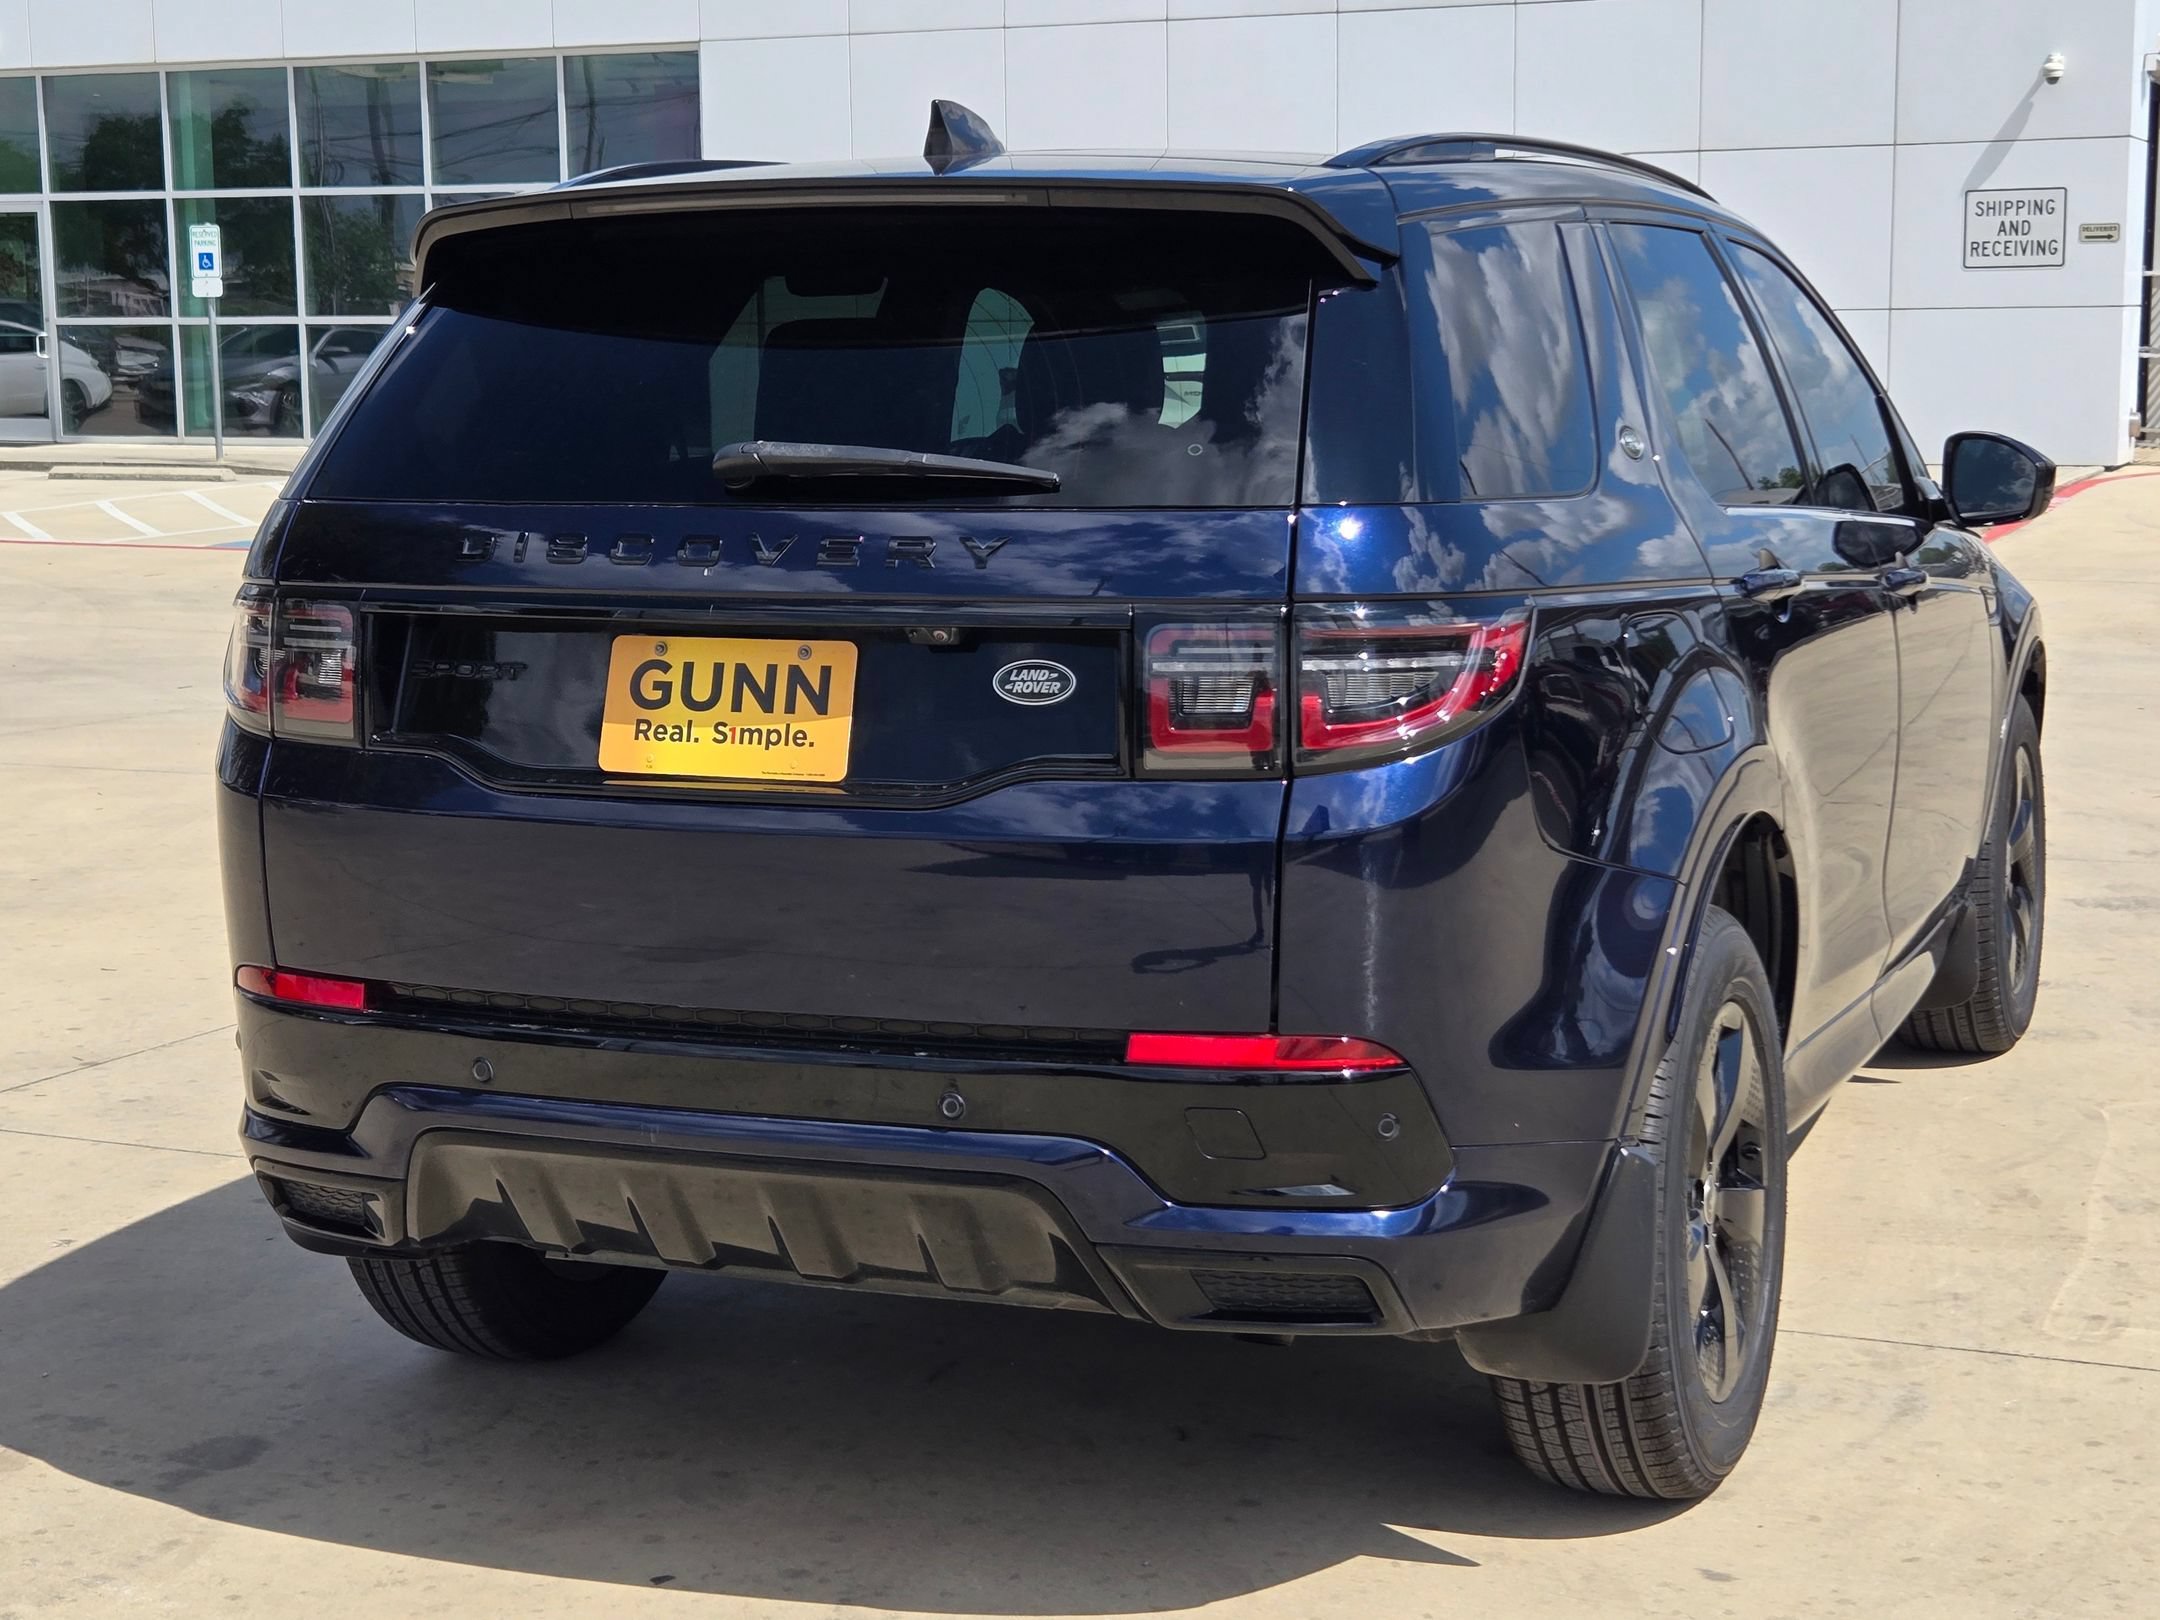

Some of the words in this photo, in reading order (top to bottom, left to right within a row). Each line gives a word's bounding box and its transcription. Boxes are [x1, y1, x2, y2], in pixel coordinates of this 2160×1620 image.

[1975, 199, 2055, 217] SHIPPING
[1997, 220, 2031, 236] AND
[1970, 240, 2058, 257] RECEIVING
[455, 530, 1014, 570] DISCOVERY
[410, 659, 529, 681] SPORT
[1010, 669, 1049, 681] LAND
[629, 659, 832, 716] GUNN
[1012, 681, 1061, 694] ROVER
[634, 719, 699, 743] Real.
